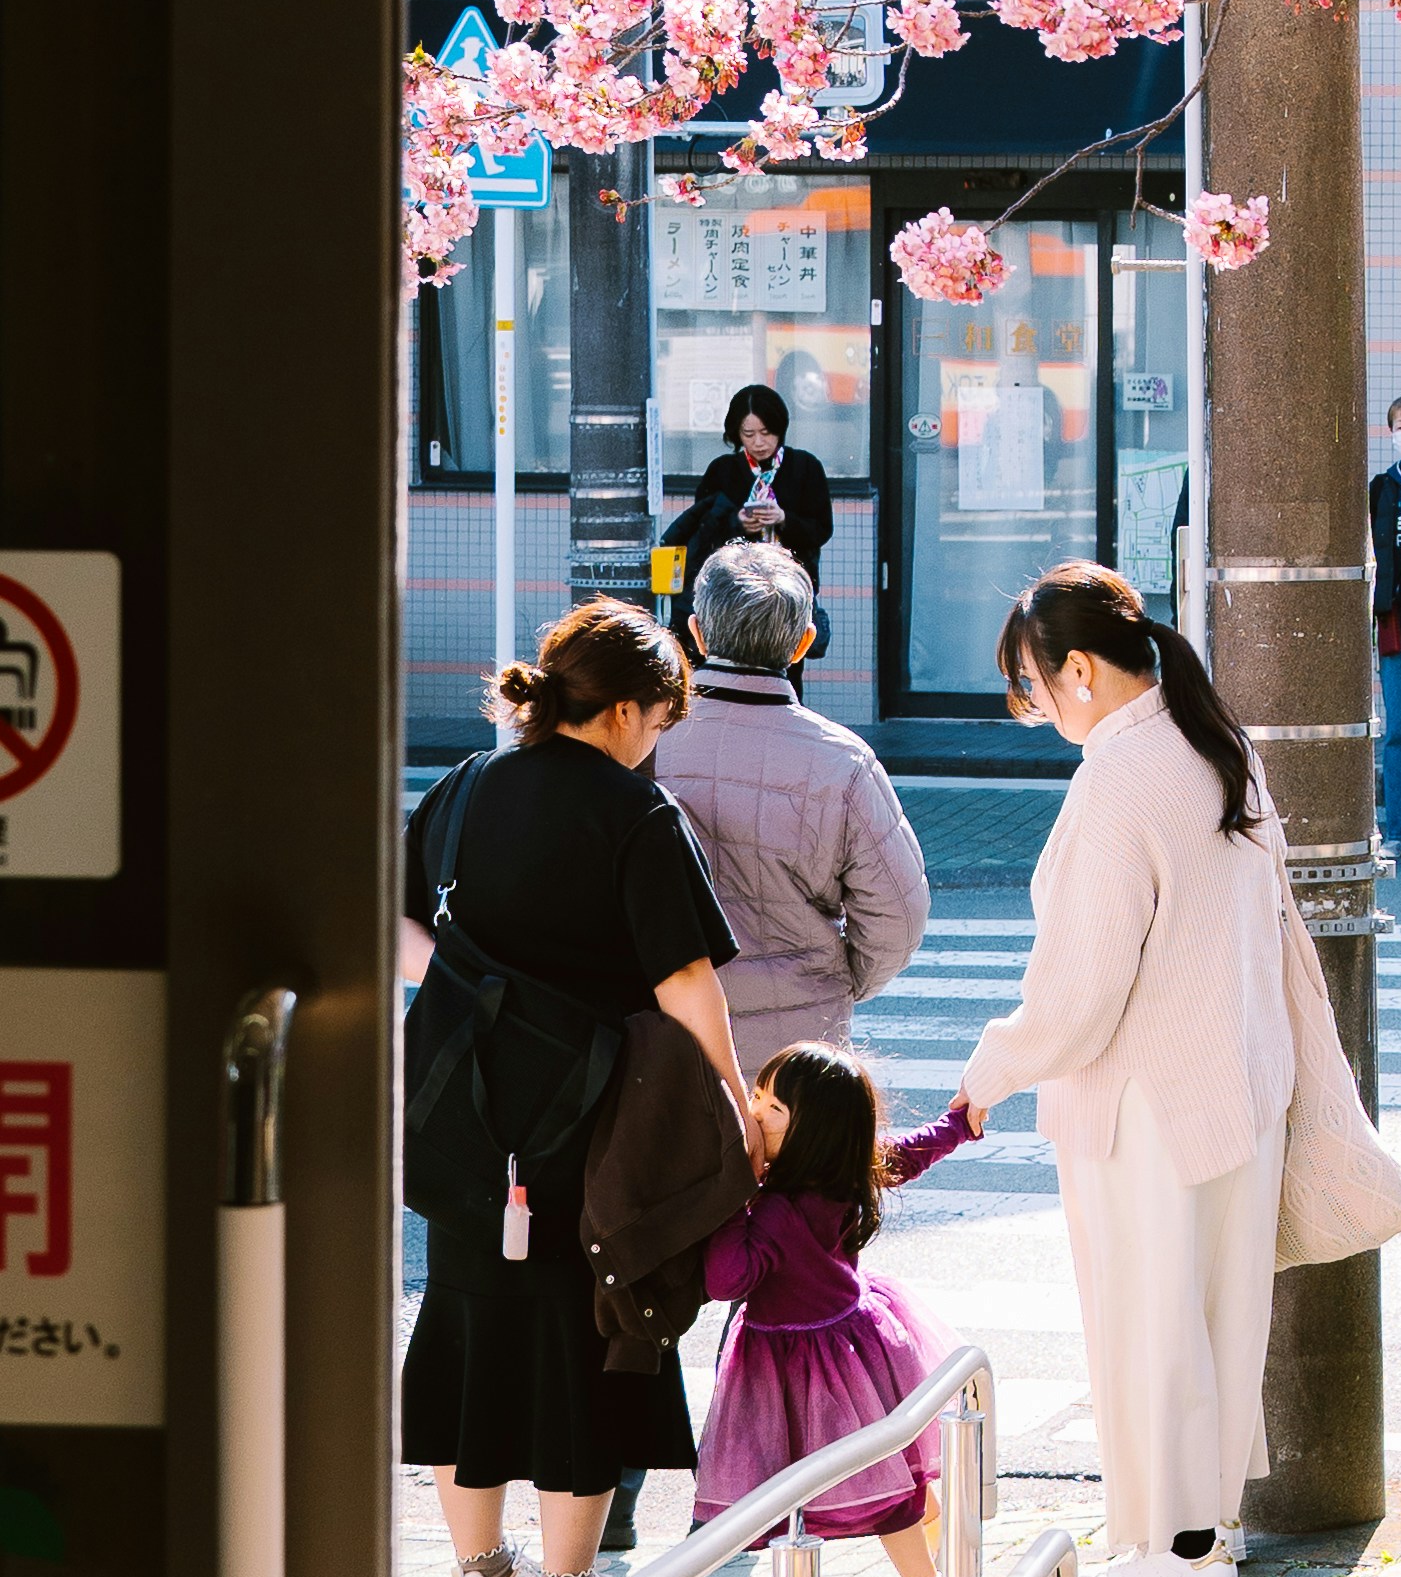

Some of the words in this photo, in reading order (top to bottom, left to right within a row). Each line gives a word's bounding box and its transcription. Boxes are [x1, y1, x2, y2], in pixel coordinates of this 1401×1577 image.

[667, 222, 681, 288] ラーメン
[732, 225, 750, 289] 焼肉定食
[777, 222, 791, 286] チャーハン
[799, 226, 817, 281] 中華丼
